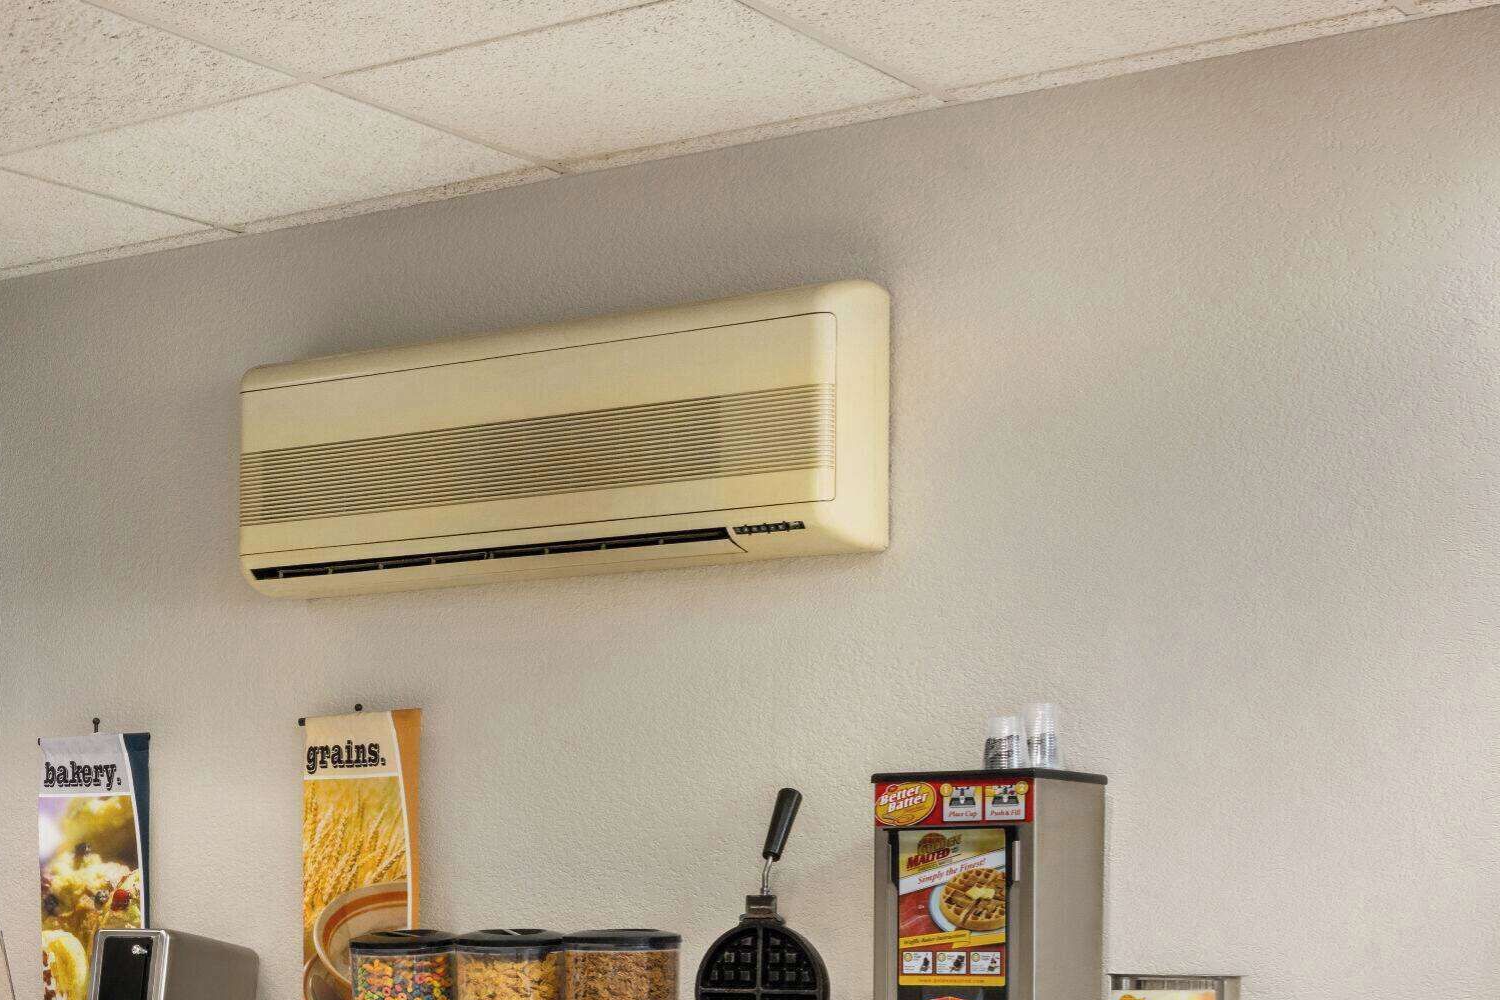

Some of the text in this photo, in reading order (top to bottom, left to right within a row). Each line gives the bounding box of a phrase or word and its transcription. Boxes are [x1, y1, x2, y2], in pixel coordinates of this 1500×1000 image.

[306, 739, 386, 775] grains.
[43, 760, 122, 791] bakery.
[879, 785, 921, 806] Better
[887, 793, 928, 813] Batter
[965, 809, 978, 819] Cup
[906, 847, 951, 870] MALTED
[917, 869, 944, 885] Simply
[945, 866, 958, 877] the
